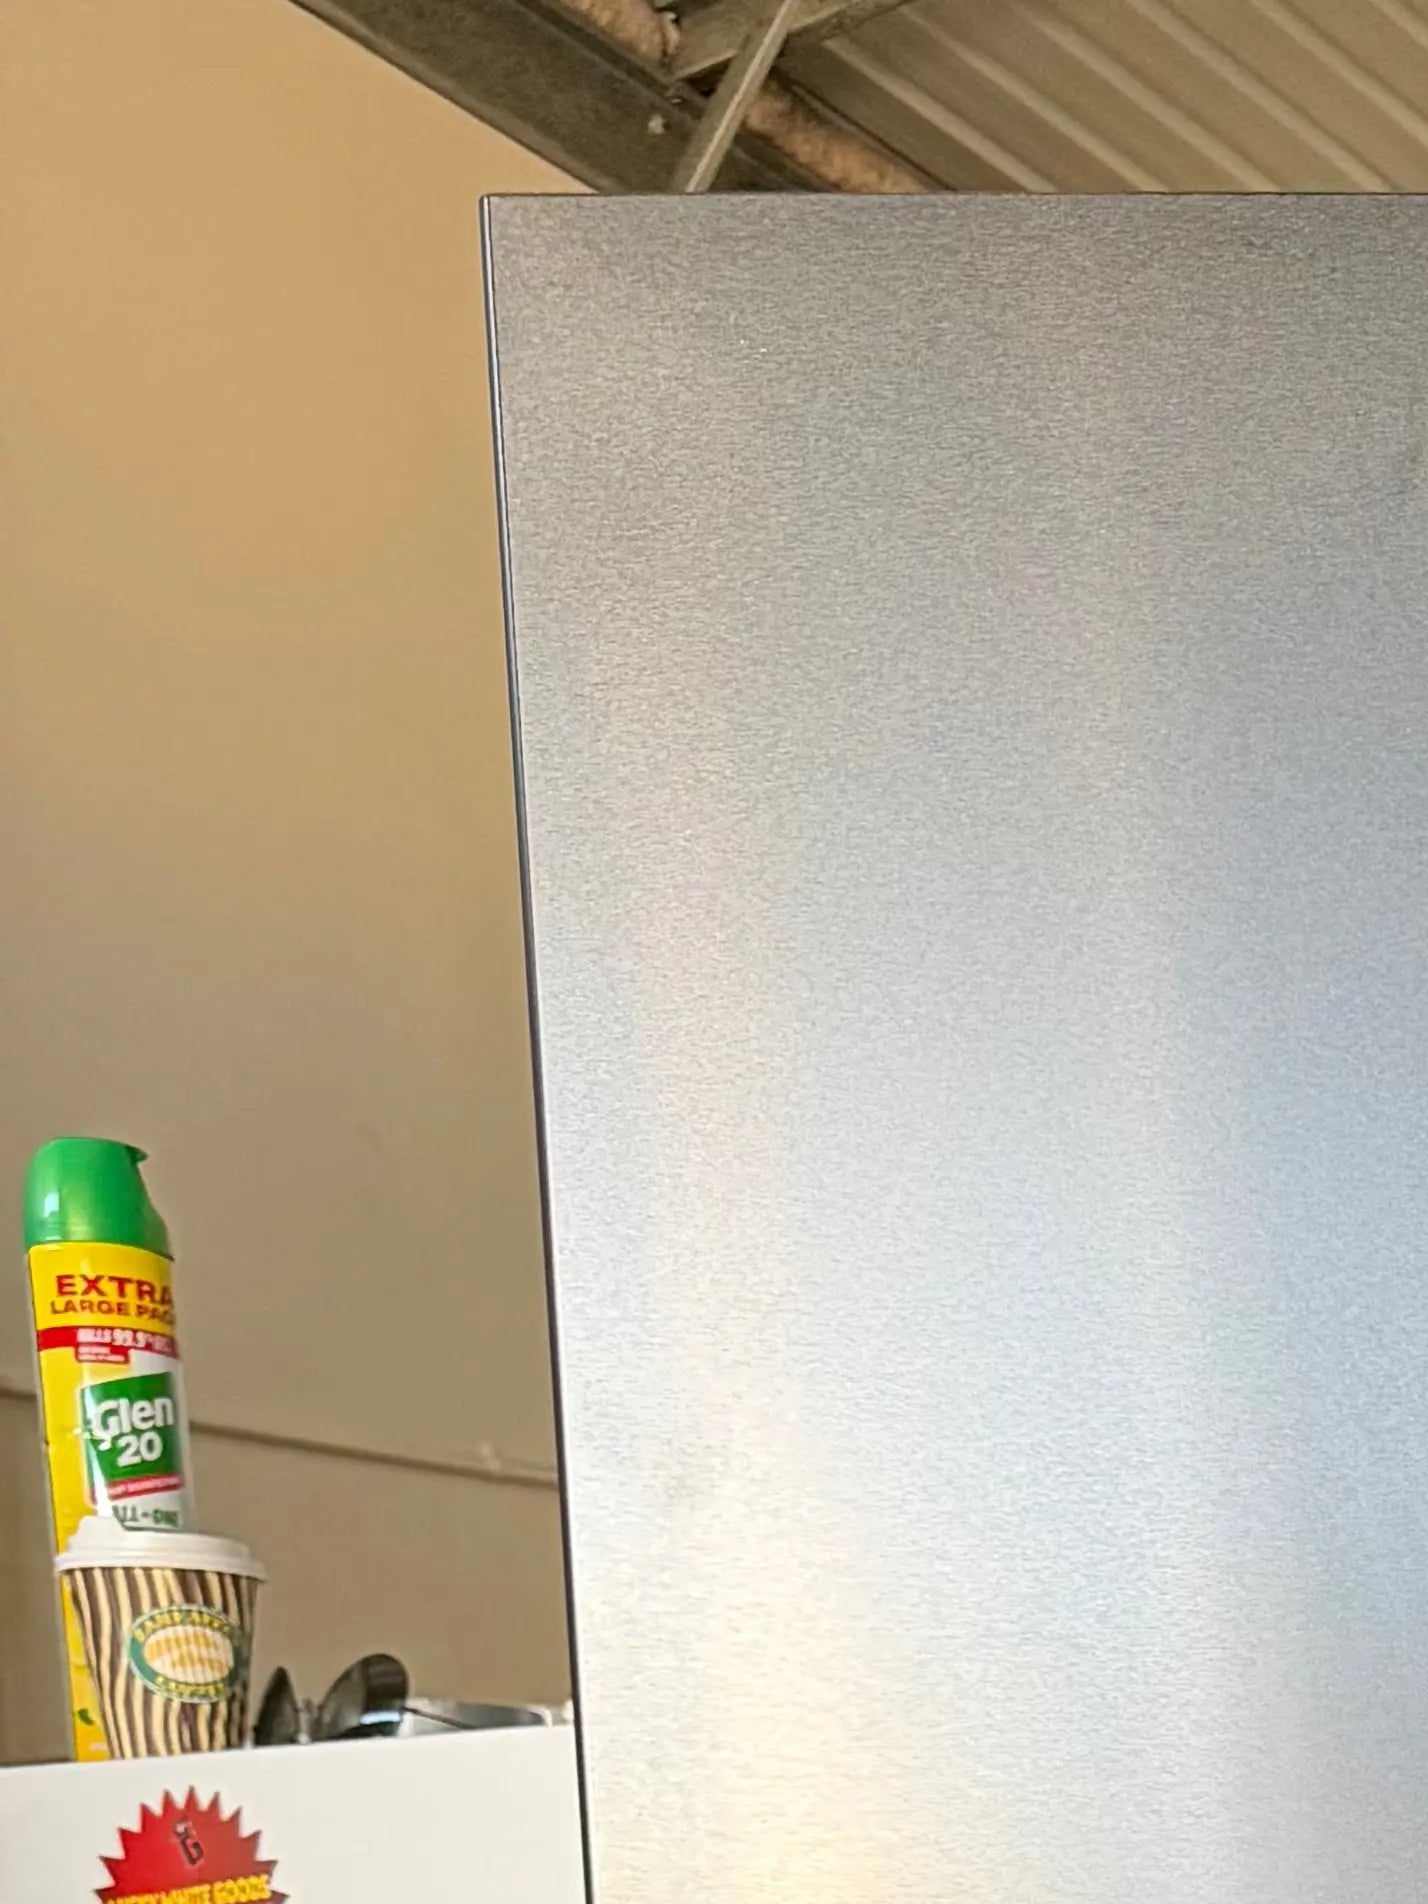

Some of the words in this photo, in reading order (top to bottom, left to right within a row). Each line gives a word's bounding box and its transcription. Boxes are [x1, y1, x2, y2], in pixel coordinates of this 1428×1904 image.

[55, 1273, 175, 1305] EXTRA
[50, 1299, 131, 1317] LARGE
[91, 1396, 174, 1451] Glen
[116, 1430, 163, 1467] 20
